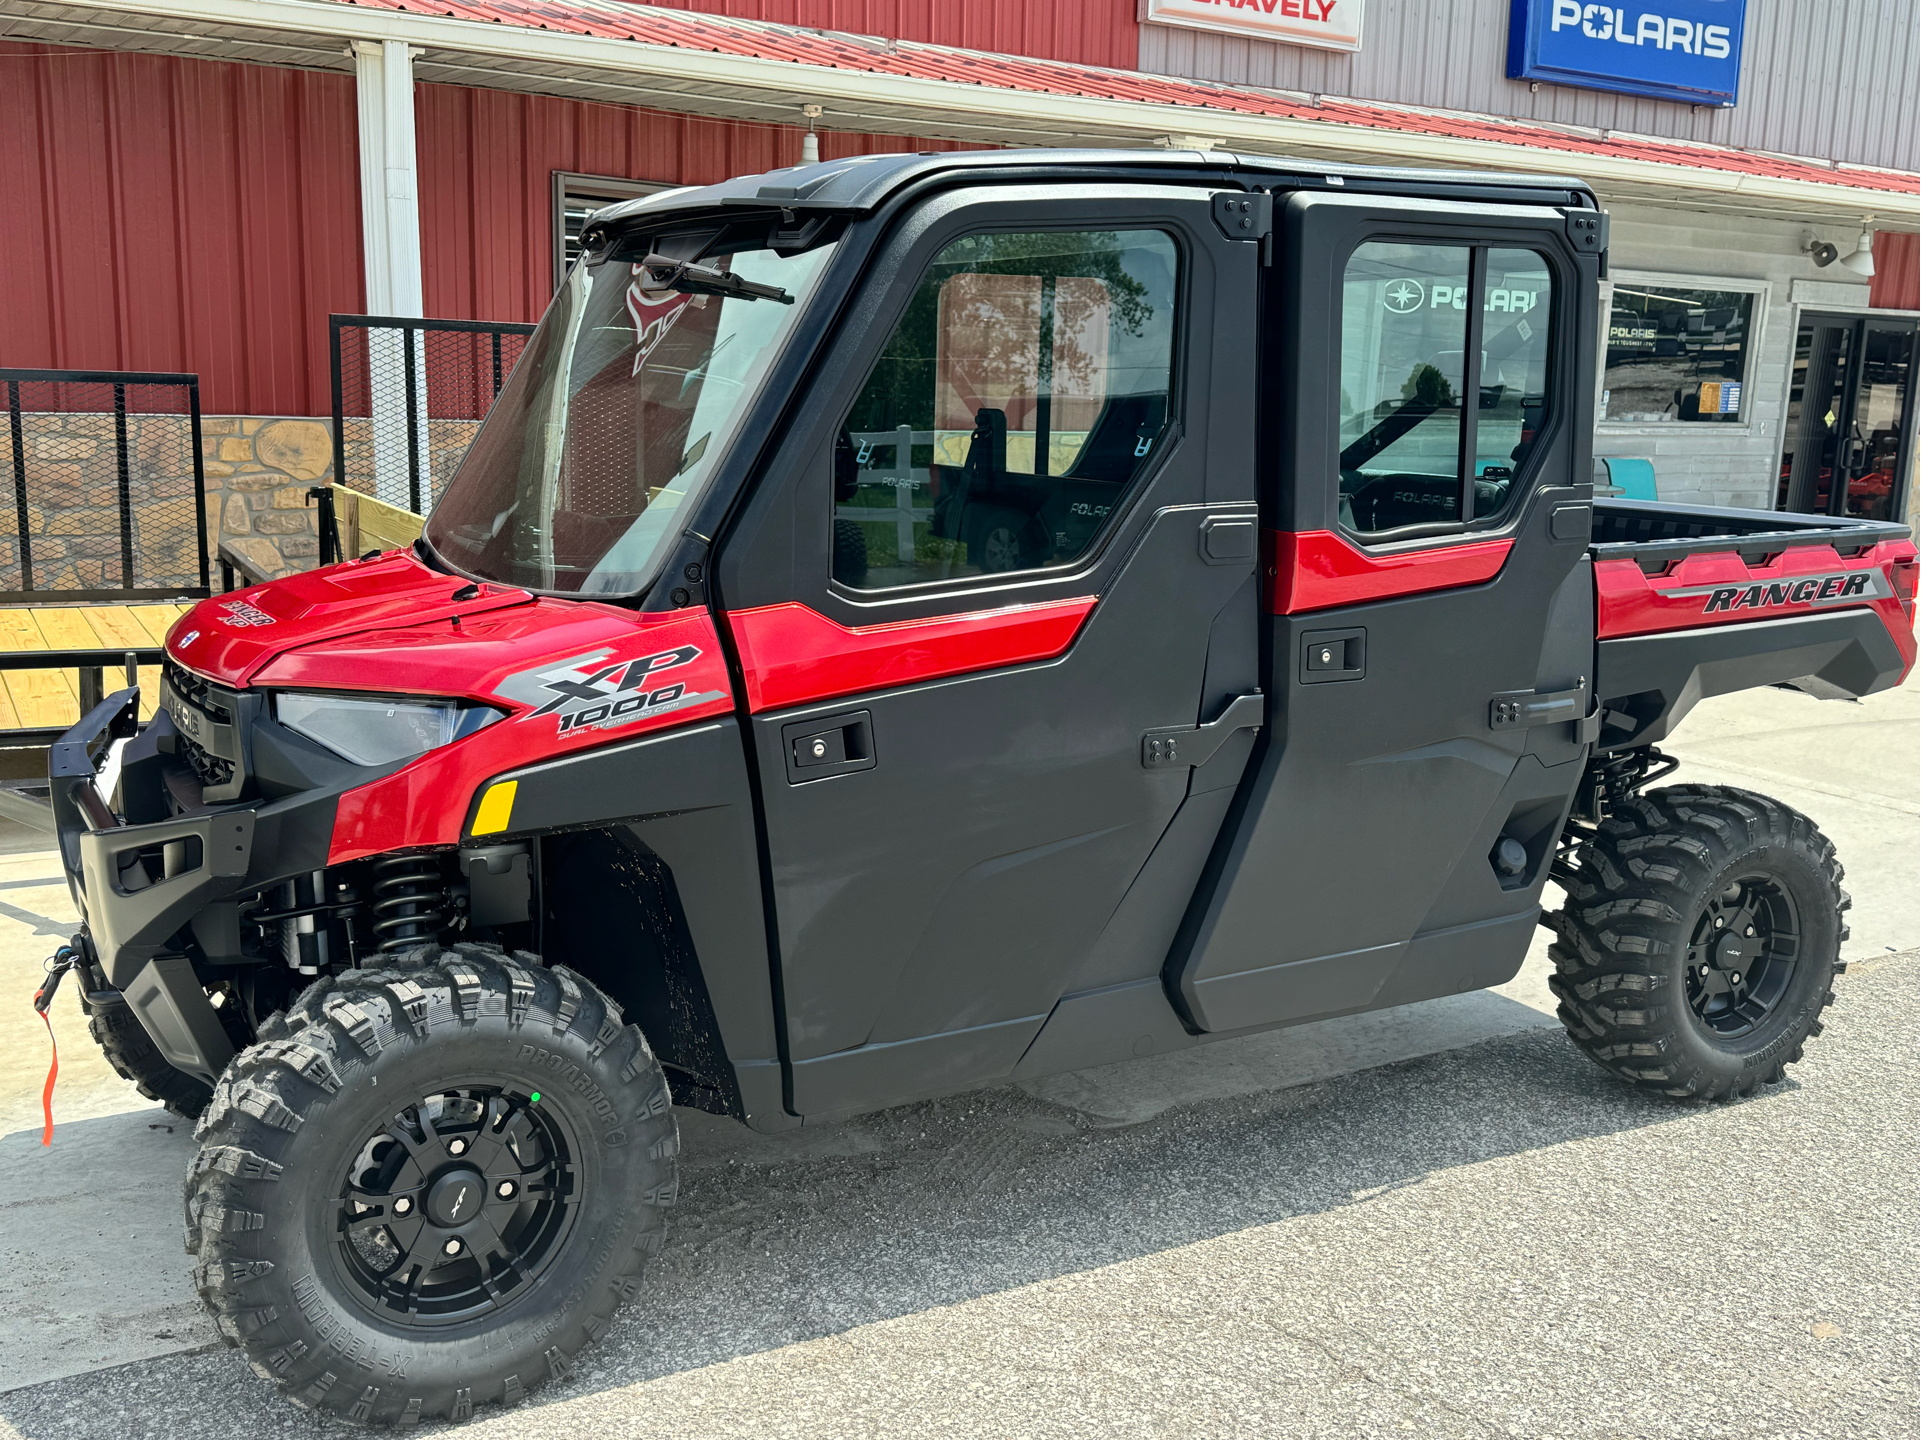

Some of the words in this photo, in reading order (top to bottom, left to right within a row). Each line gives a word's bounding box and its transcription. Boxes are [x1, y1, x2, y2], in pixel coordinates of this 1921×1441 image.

[1191, 0, 1338, 23] VELY
[1551, 0, 1731, 59] POLARIS
[1610, 327, 1655, 339] POLARIS
[882, 477, 920, 490] POLARIS
[1393, 491, 1456, 508] POLARIS
[1701, 573, 1871, 614] RANGER
[216, 615, 250, 627] XP
[218, 600, 277, 627] RANGER
[515, 644, 703, 724] XP
[557, 682, 686, 734] 1000
[558, 728, 588, 740] DUAL
[591, 710, 652, 731] OVERHEAD
[654, 702, 680, 714] CAM
[1743, 1003, 1814, 1070] X-TERRAIN
[517, 1044, 564, 1070] PRO
[561, 1065, 619, 1128] ARMOR
[451, 1186, 467, 1219] XP
[292, 1273, 412, 1378] X-TERRAIN
